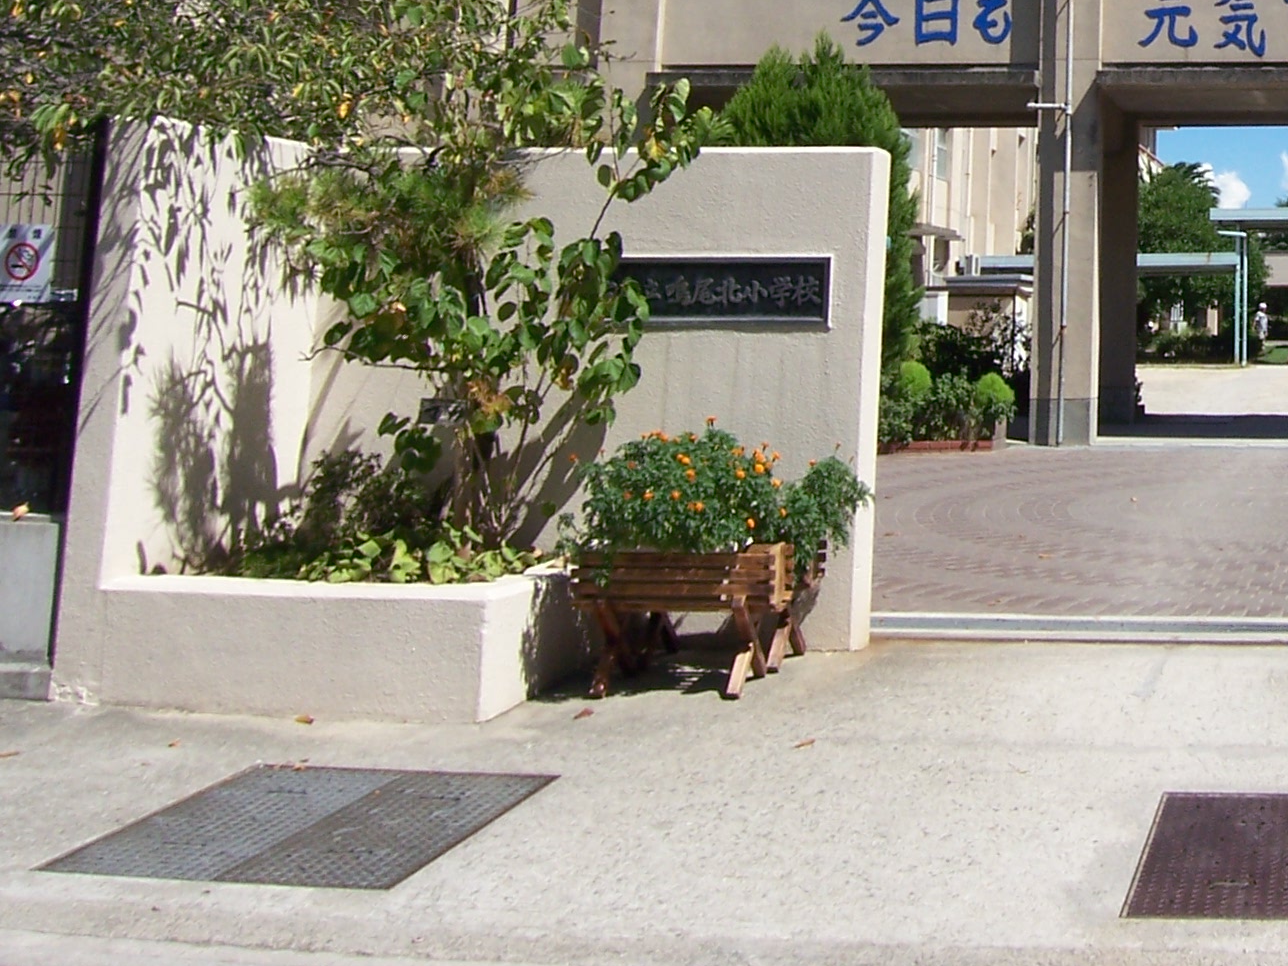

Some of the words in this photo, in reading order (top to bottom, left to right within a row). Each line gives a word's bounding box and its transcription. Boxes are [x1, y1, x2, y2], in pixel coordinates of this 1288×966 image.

[605, 275, 822, 307] 立鳴尾北小学校
